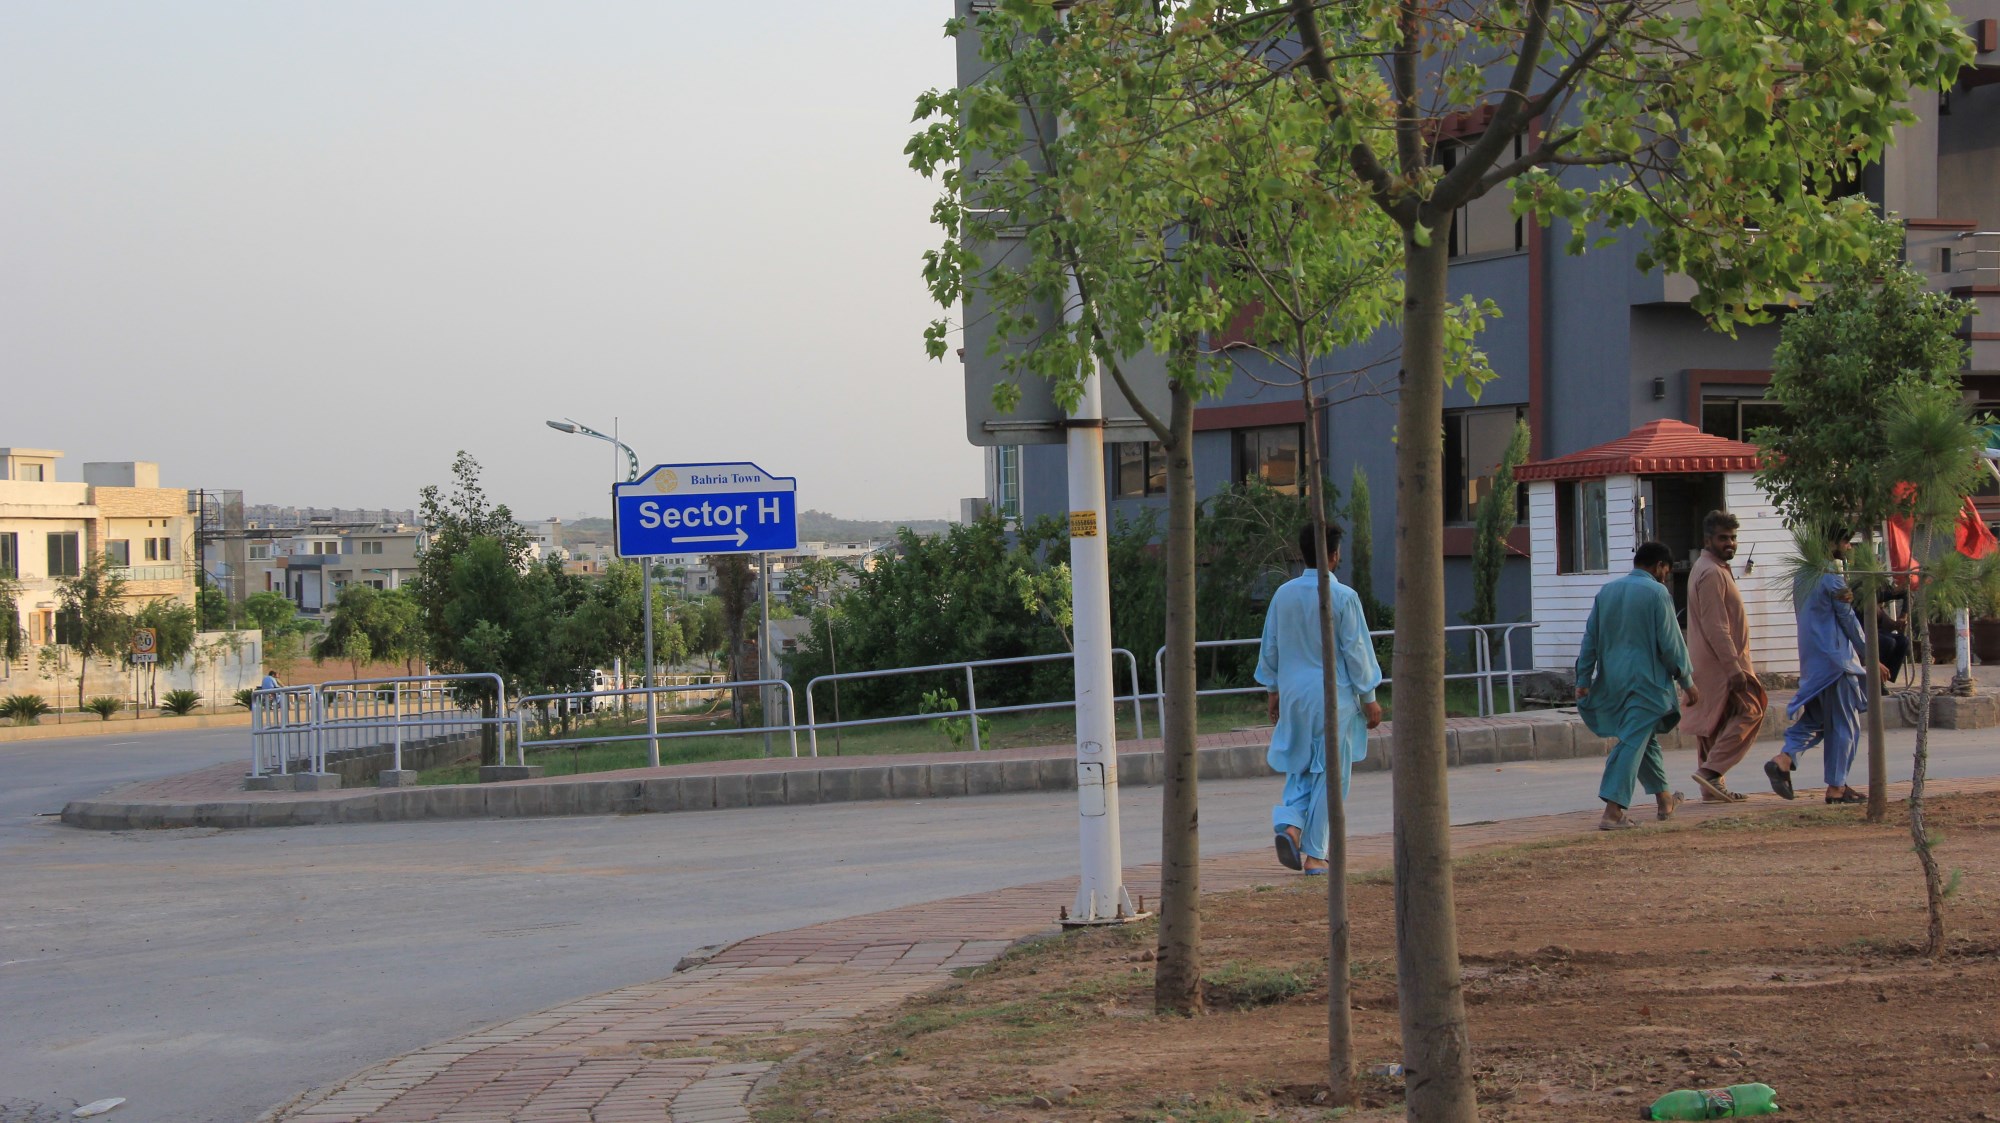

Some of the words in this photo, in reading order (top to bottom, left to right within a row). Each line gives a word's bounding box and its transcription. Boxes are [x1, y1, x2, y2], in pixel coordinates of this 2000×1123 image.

[691, 474, 728, 485] Bahria
[731, 473, 761, 483] Town
[639, 500, 748, 529] Sector
[758, 497, 780, 524] H
